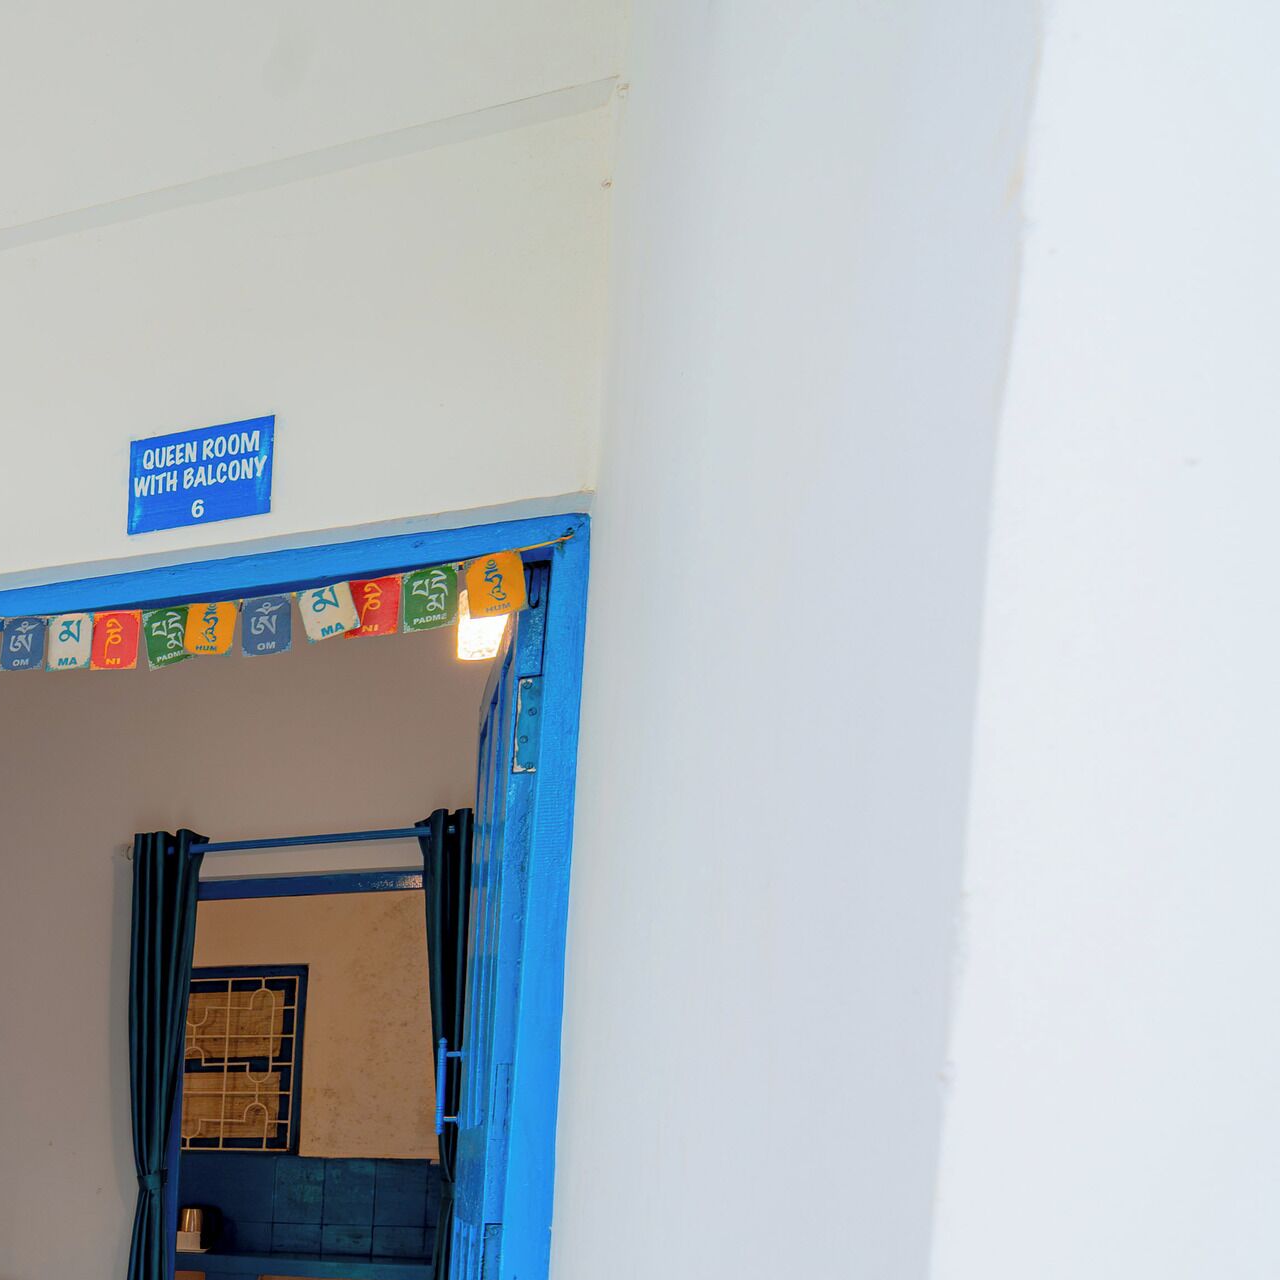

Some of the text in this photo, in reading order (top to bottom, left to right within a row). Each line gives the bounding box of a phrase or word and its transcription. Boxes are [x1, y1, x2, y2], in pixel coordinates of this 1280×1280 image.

[142, 430, 260, 470] QUEEN ROOM
[134, 455, 268, 498] WITH BALCONY
[191, 499, 205, 518] 6
[486, 602, 511, 613] HUM
[413, 612, 448, 625] PADME
[320, 622, 345, 638] MA
[361, 624, 379, 632] NI
[257, 641, 276, 650] OM
[12, 658, 30, 667] OM
[57, 656, 77, 666] MA
[105, 657, 121, 665] NI
